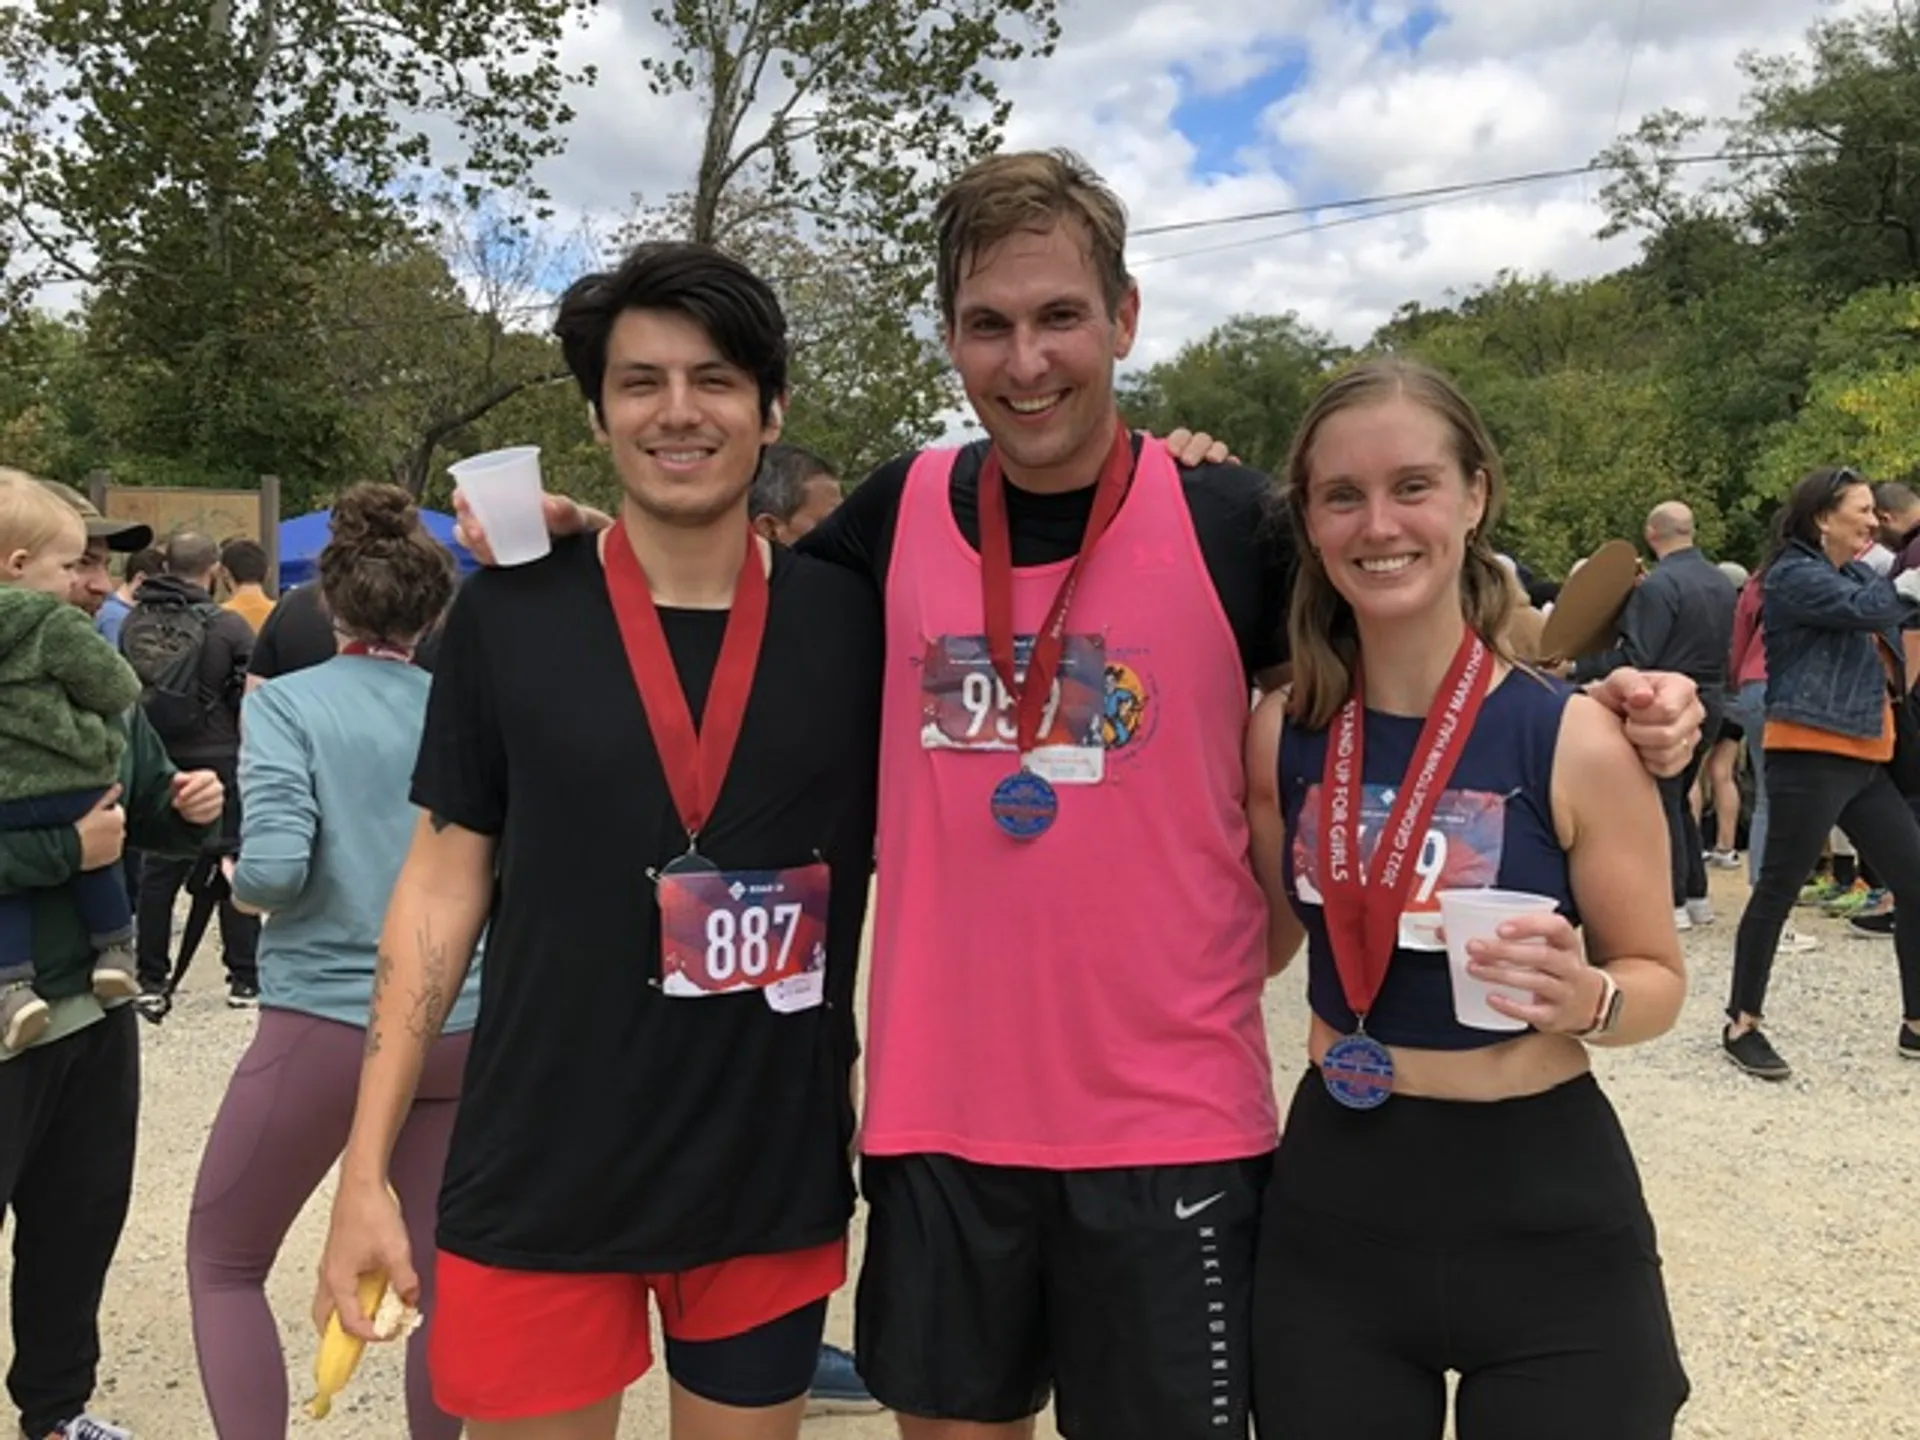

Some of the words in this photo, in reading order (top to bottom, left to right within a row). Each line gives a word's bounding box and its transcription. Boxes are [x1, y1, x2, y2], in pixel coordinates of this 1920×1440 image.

[1335, 759, 1352, 784] UP
[1394, 750, 1443, 850] GEORGETOWN
[1437, 713, 1460, 749] HALF
[1331, 786, 1349, 823] FOR
[1329, 824, 1349, 881] GIRLS
[706, 903, 802, 980] 887
[1199, 1226, 1222, 1286] NIKE
[1207, 1301, 1229, 1425] RUNNING
